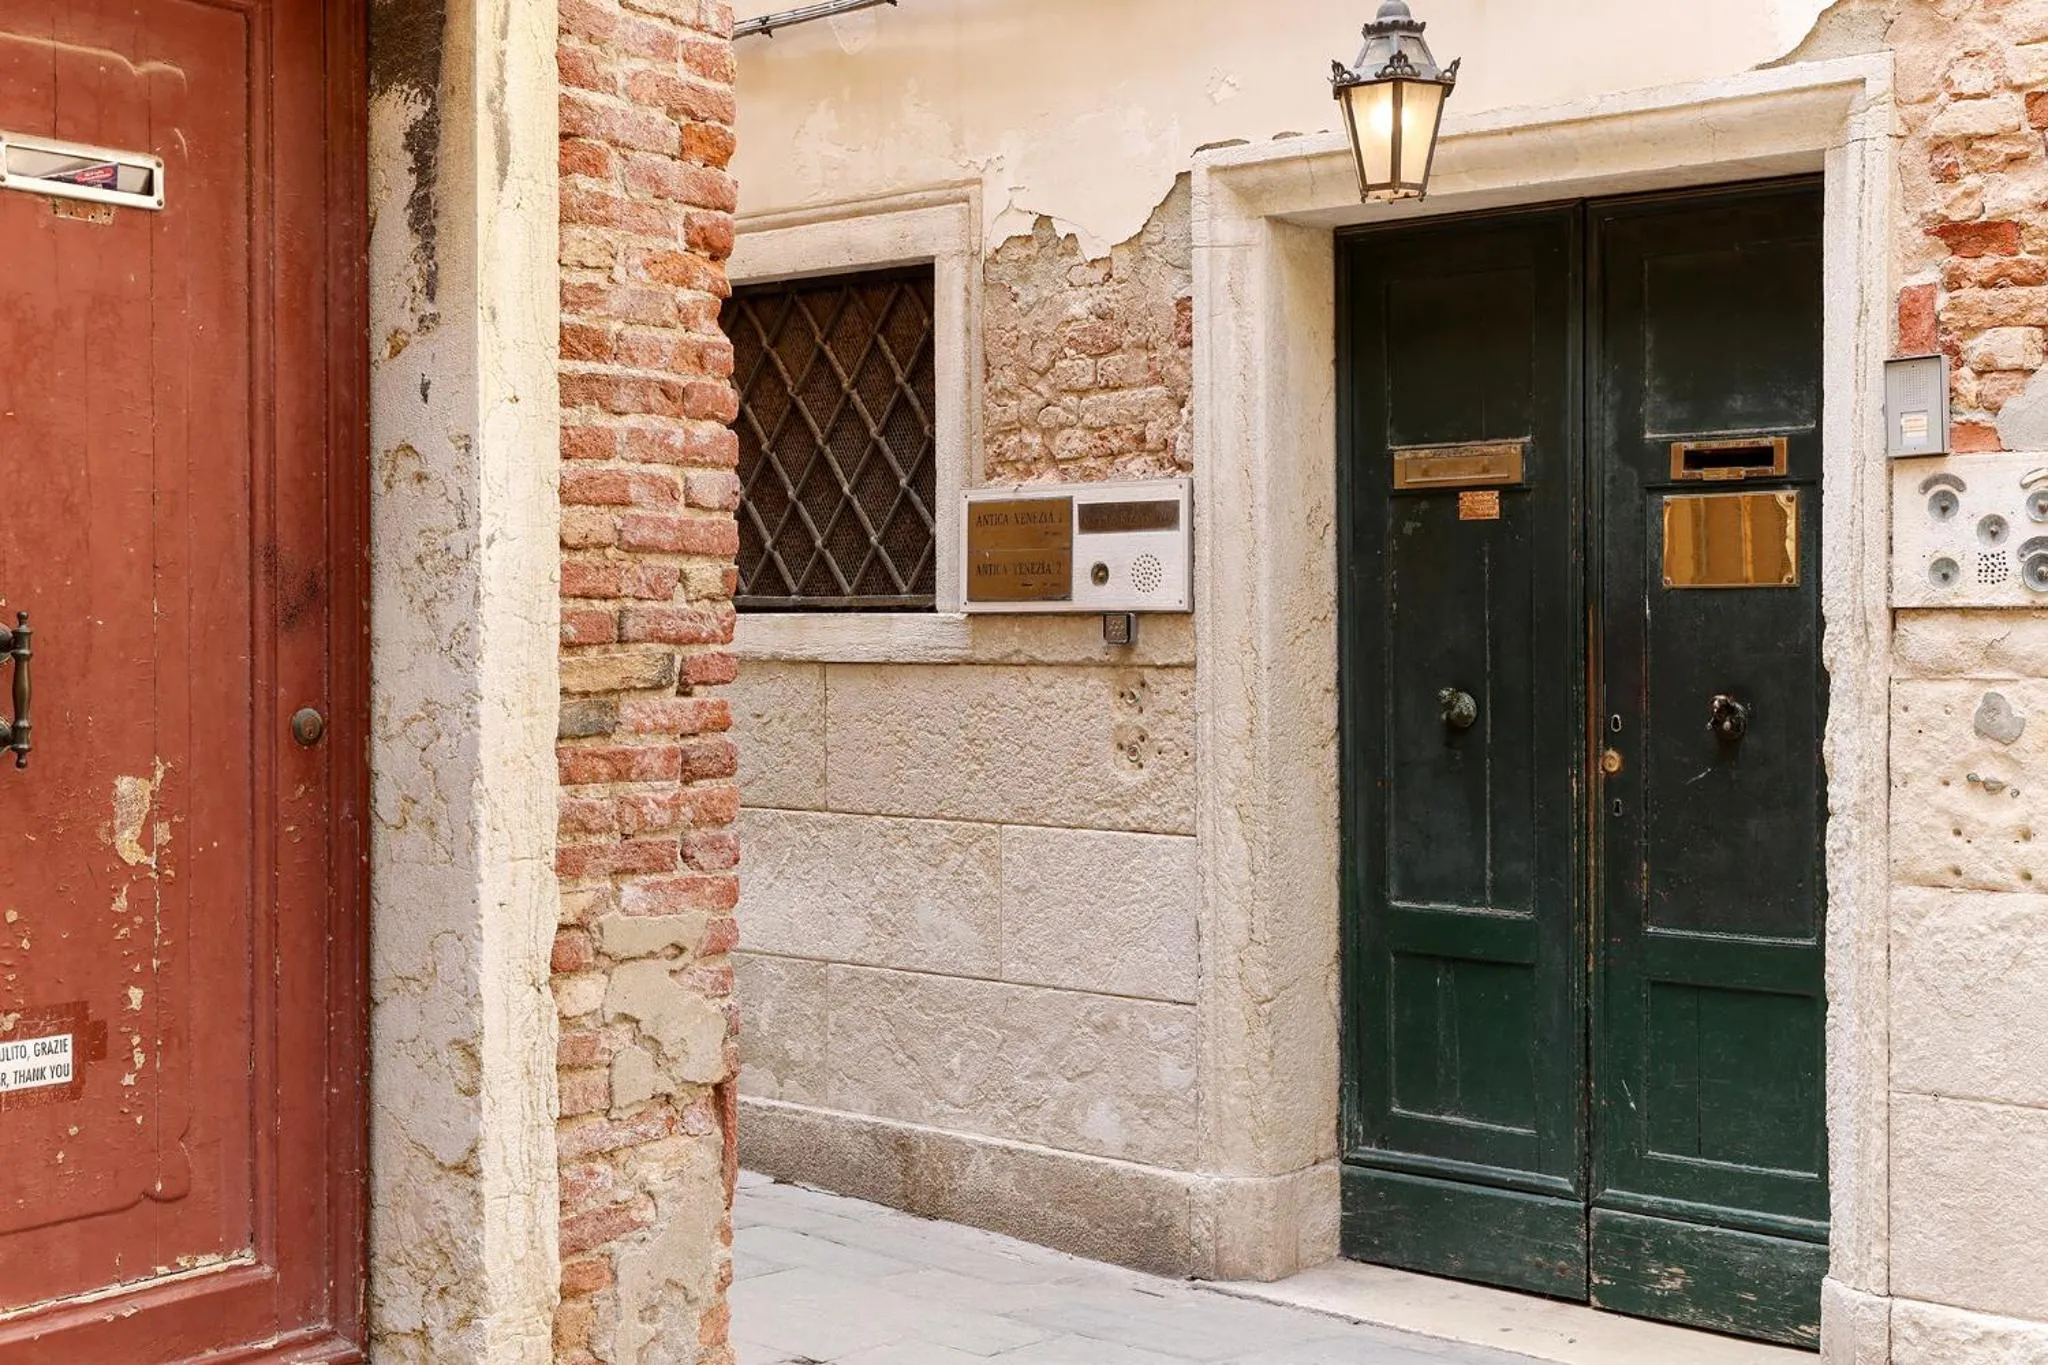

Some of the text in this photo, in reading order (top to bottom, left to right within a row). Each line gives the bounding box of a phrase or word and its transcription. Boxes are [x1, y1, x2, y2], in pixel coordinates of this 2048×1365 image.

[976, 511, 1008, 528] ANTICA
[1014, 510, 1054, 525] VENEZIA
[975, 563, 1008, 576] ANTICA
[1013, 560, 1053, 575] VENEZIA
[33, 1038, 69, 1057] GRAZIE
[13, 1066, 47, 1084] THANK
[50, 1063, 70, 1078] YOU
